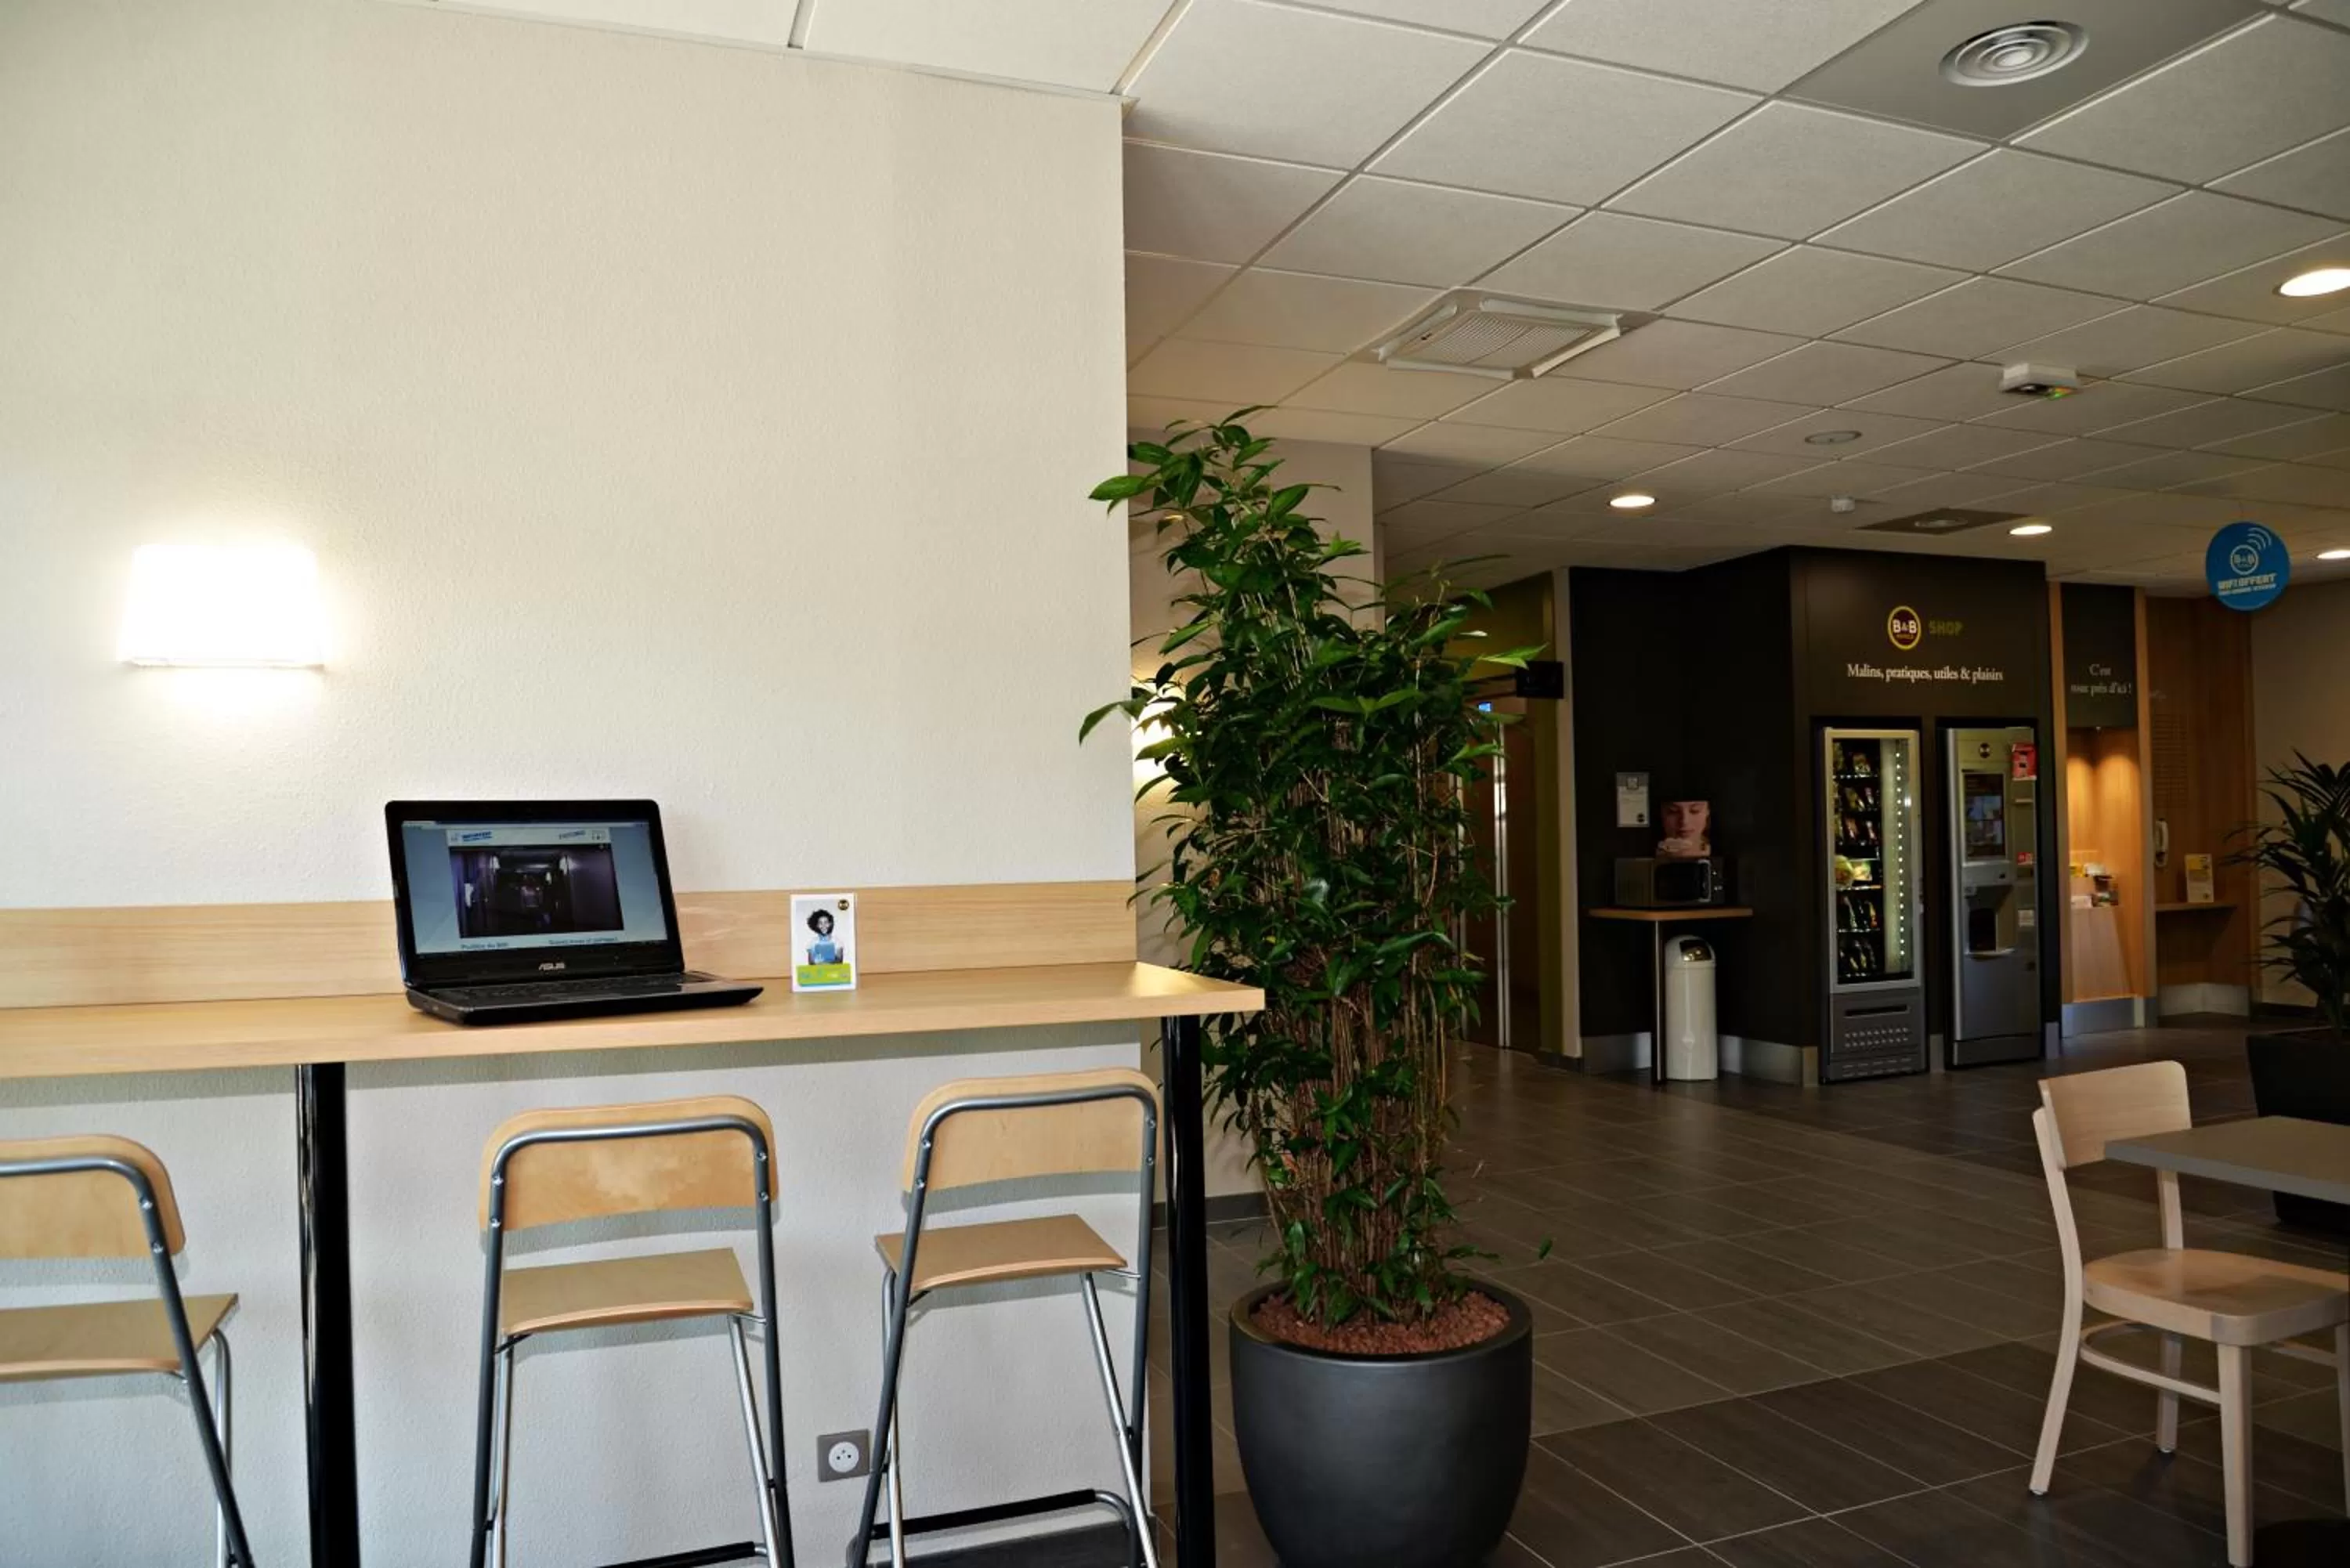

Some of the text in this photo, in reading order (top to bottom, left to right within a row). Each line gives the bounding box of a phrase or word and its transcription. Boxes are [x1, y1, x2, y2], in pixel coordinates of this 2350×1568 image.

[1892, 618, 1917, 634] B&B
[1929, 619, 1962, 635] SHOP
[1847, 663, 2004, 684] Malins, pratiques, utiles & plaisirs
[538, 962, 565, 970] ASUS
